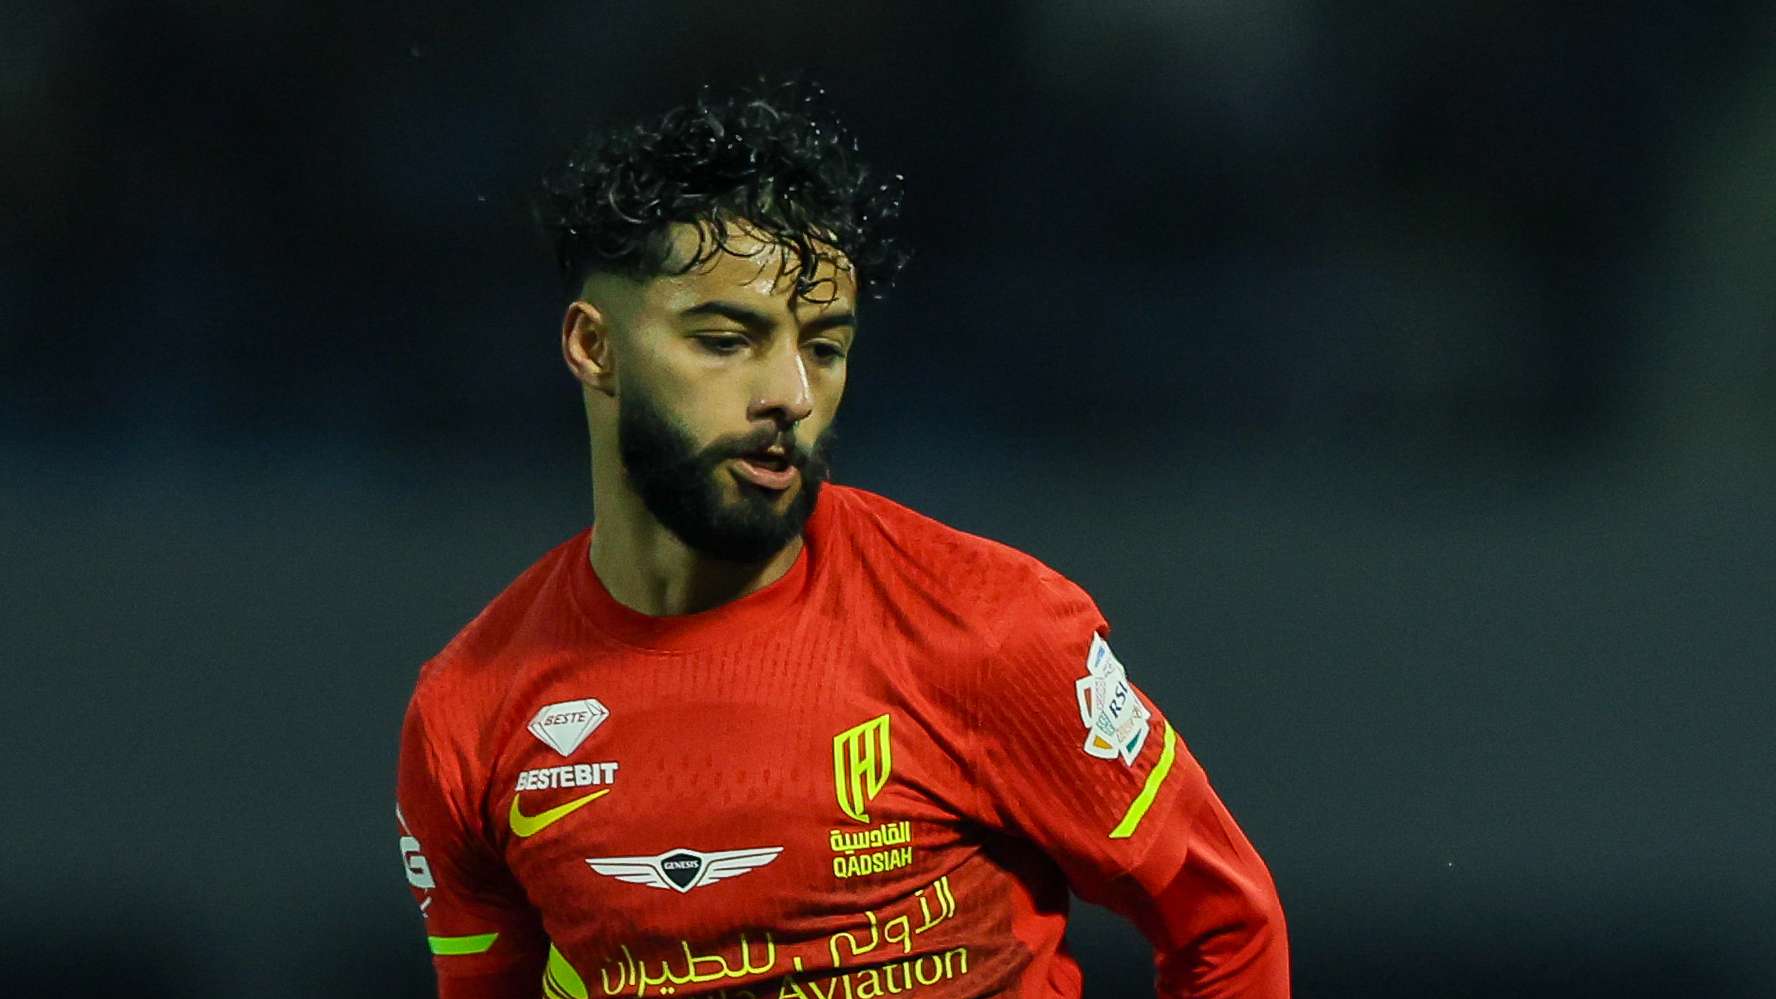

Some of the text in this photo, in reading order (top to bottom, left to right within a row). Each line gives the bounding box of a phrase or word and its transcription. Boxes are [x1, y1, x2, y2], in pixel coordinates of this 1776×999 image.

[544, 711, 588, 726] BESTE
[515, 762, 619, 791] BESTEBIT
[830, 821, 911, 854] القادسية
[663, 860, 700, 871] GENESIS
[833, 847, 912, 879] QADSIAH
